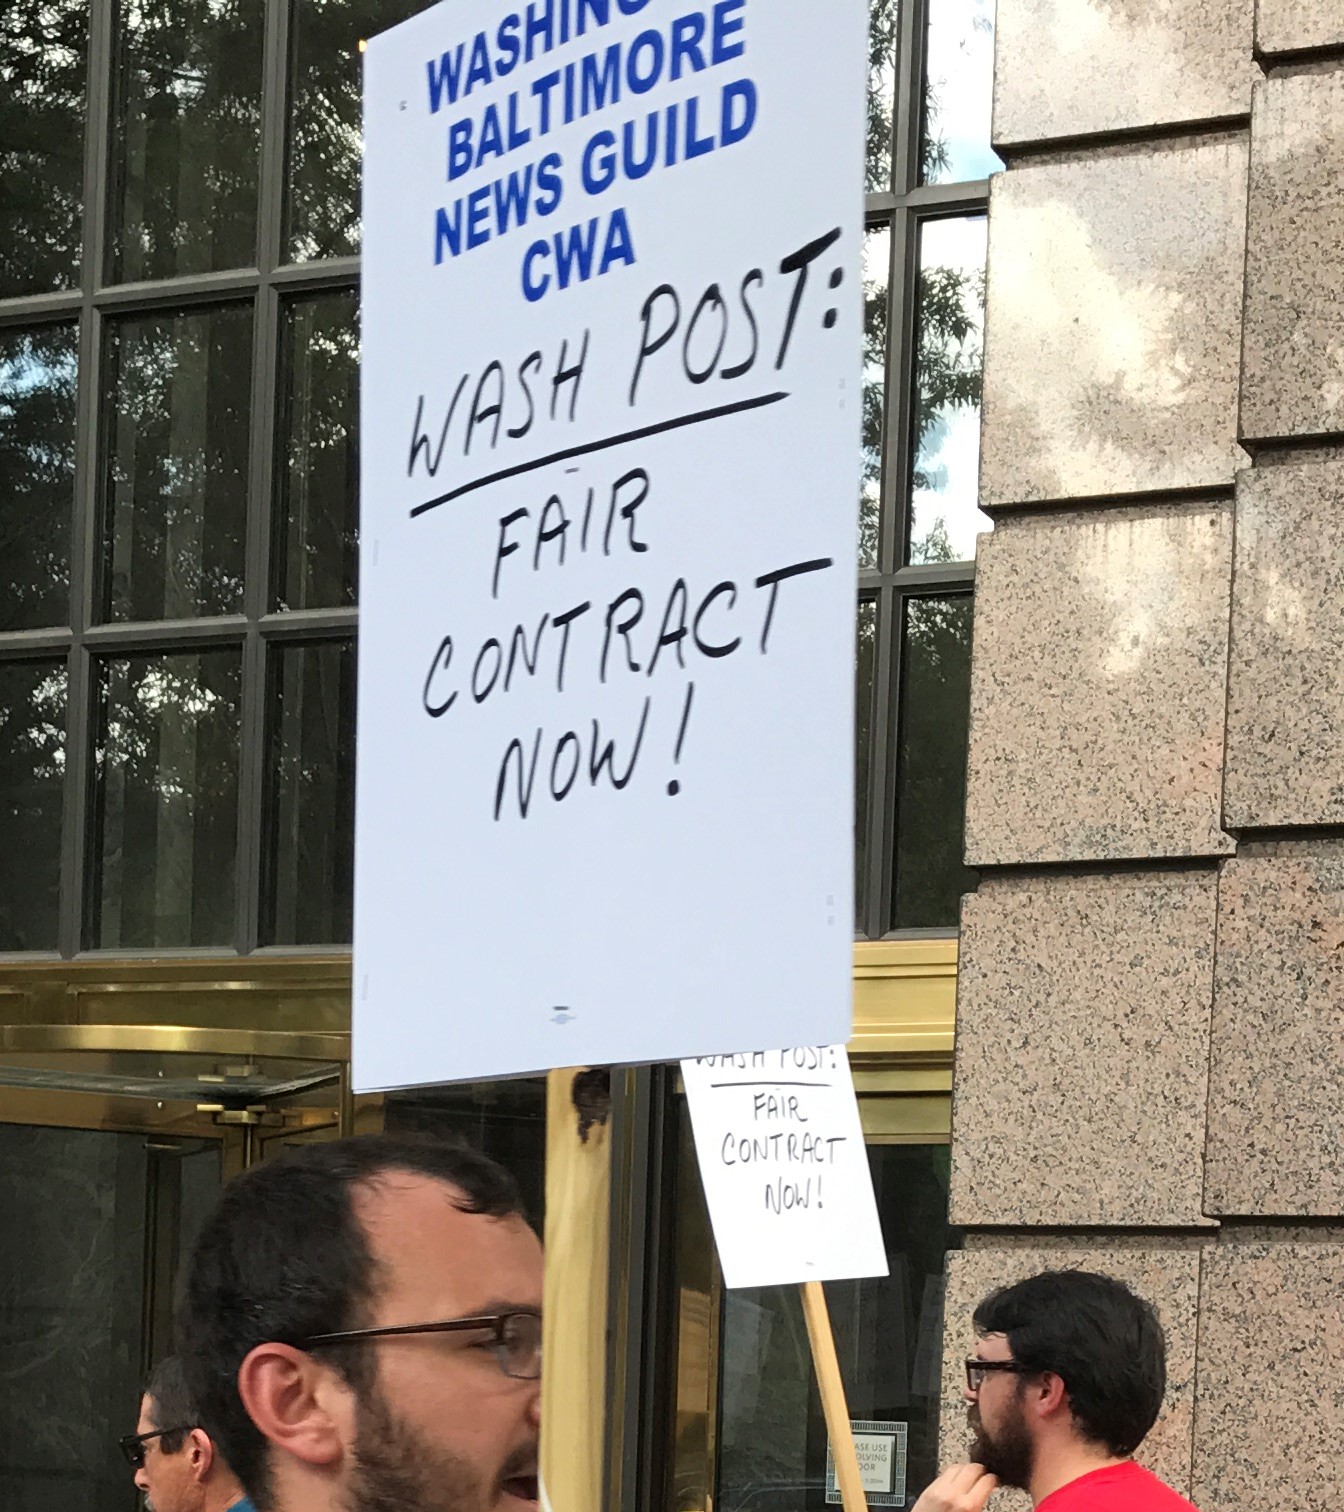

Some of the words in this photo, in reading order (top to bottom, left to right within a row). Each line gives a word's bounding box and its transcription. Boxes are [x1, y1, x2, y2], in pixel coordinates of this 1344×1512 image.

[446, 0, 747, 182] BALTIMORE
[433, 151, 563, 265] NEWS
[580, 77, 759, 196] GUILD
[522, 207, 637, 302] CWA
[407, 328, 591, 477] WASH
[628, 226, 846, 407] POST:
[492, 467, 651, 598] FAIR
[423, 557, 833, 718] CONTRACT
[493, 681, 695, 821] NOW!
[720, 1132, 847, 1166] CONTRACT
[753, 1092, 808, 1122] FAIR
[765, 1174, 824, 1215] NOW!
